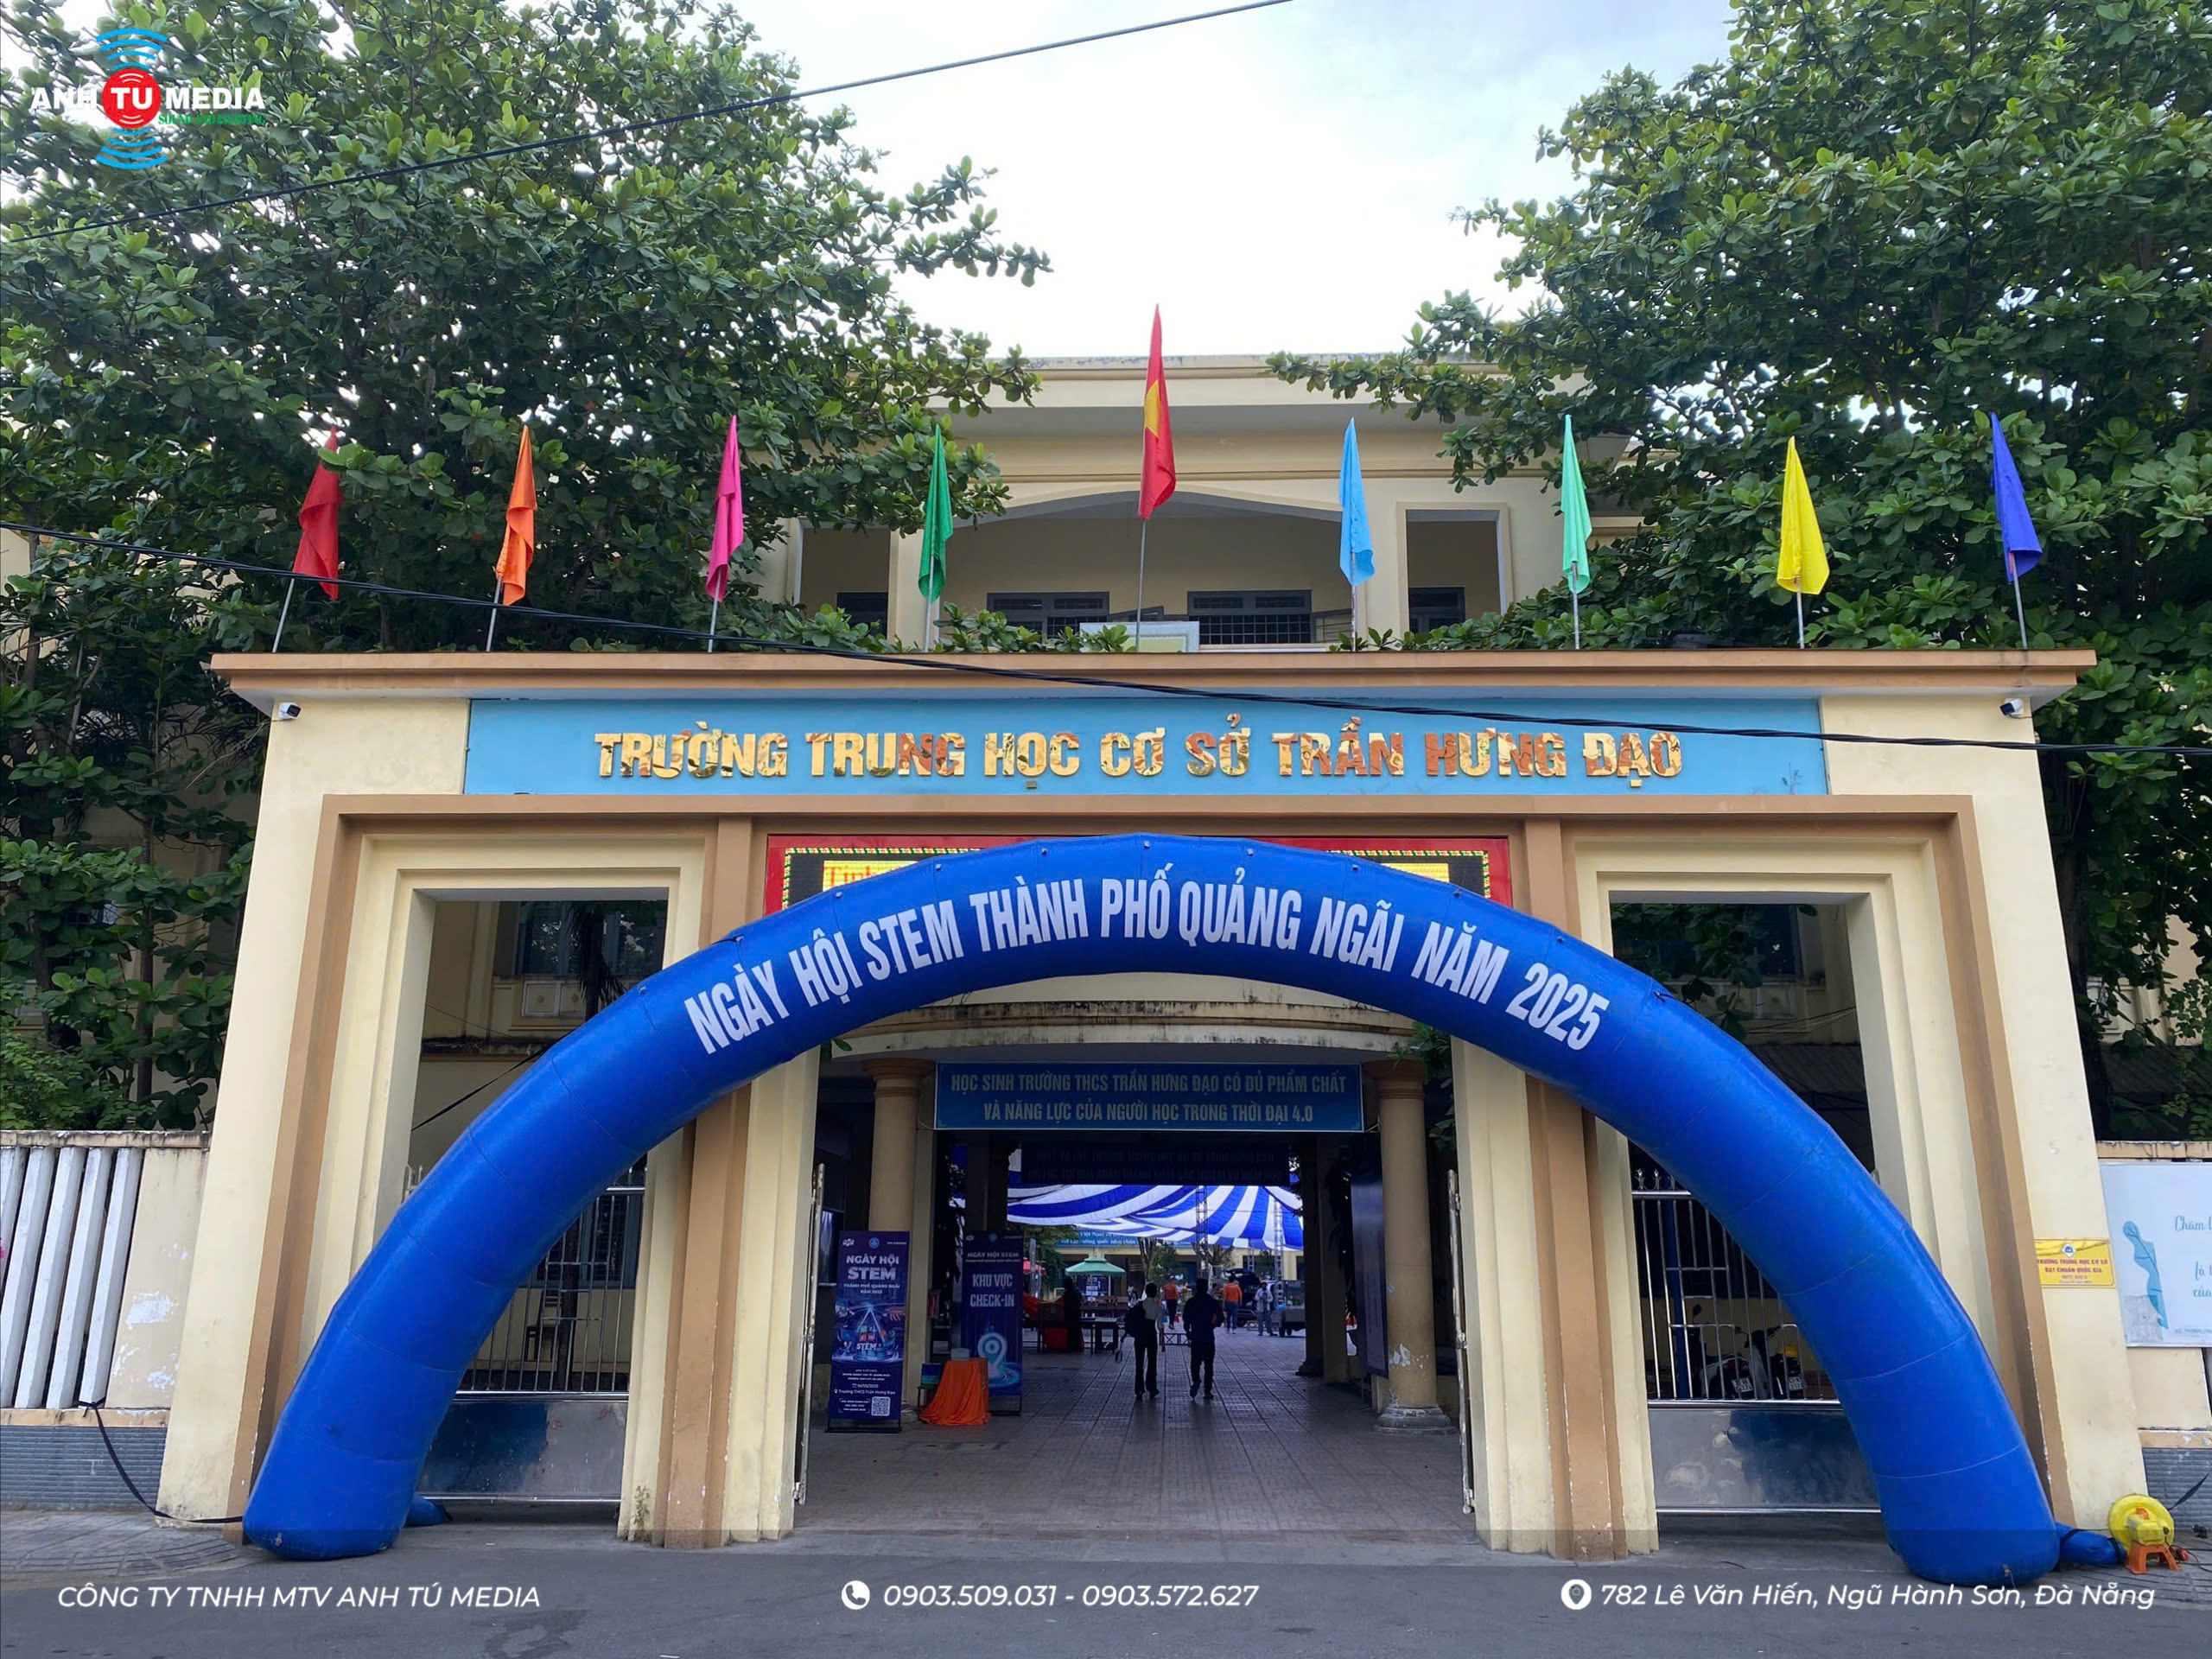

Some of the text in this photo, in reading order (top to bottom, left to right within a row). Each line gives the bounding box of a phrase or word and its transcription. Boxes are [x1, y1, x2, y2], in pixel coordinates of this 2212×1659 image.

[594, 713, 1683, 789] TRƯỜNG TRUNG HỌC CƠ SỞ TRẦN HƯNG ĐẠO
[683, 862, 1611, 1054] NGÀY HỘI STEM THÀNH PHỐ QUẢNG NGÃI NĂM 2025
[950, 1069, 1346, 1096] HỌC SINH TRƯỜNG THCS TRẦN HƯNG ĐẠO CÓ ĐỦ PHẨM CHẤT
[983, 1097, 1313, 1126] VÀ NĂNG LỰC CỦA NGƯỜI HỌC TRONG THỜI ĐẠI 4.0
[846, 1254, 899, 1267] NGÀY HỘI
[847, 1266, 896, 1281] STEM
[972, 1273, 1014, 1289] KHU VỰC
[969, 1294, 1015, 1307] CHECK-IN
